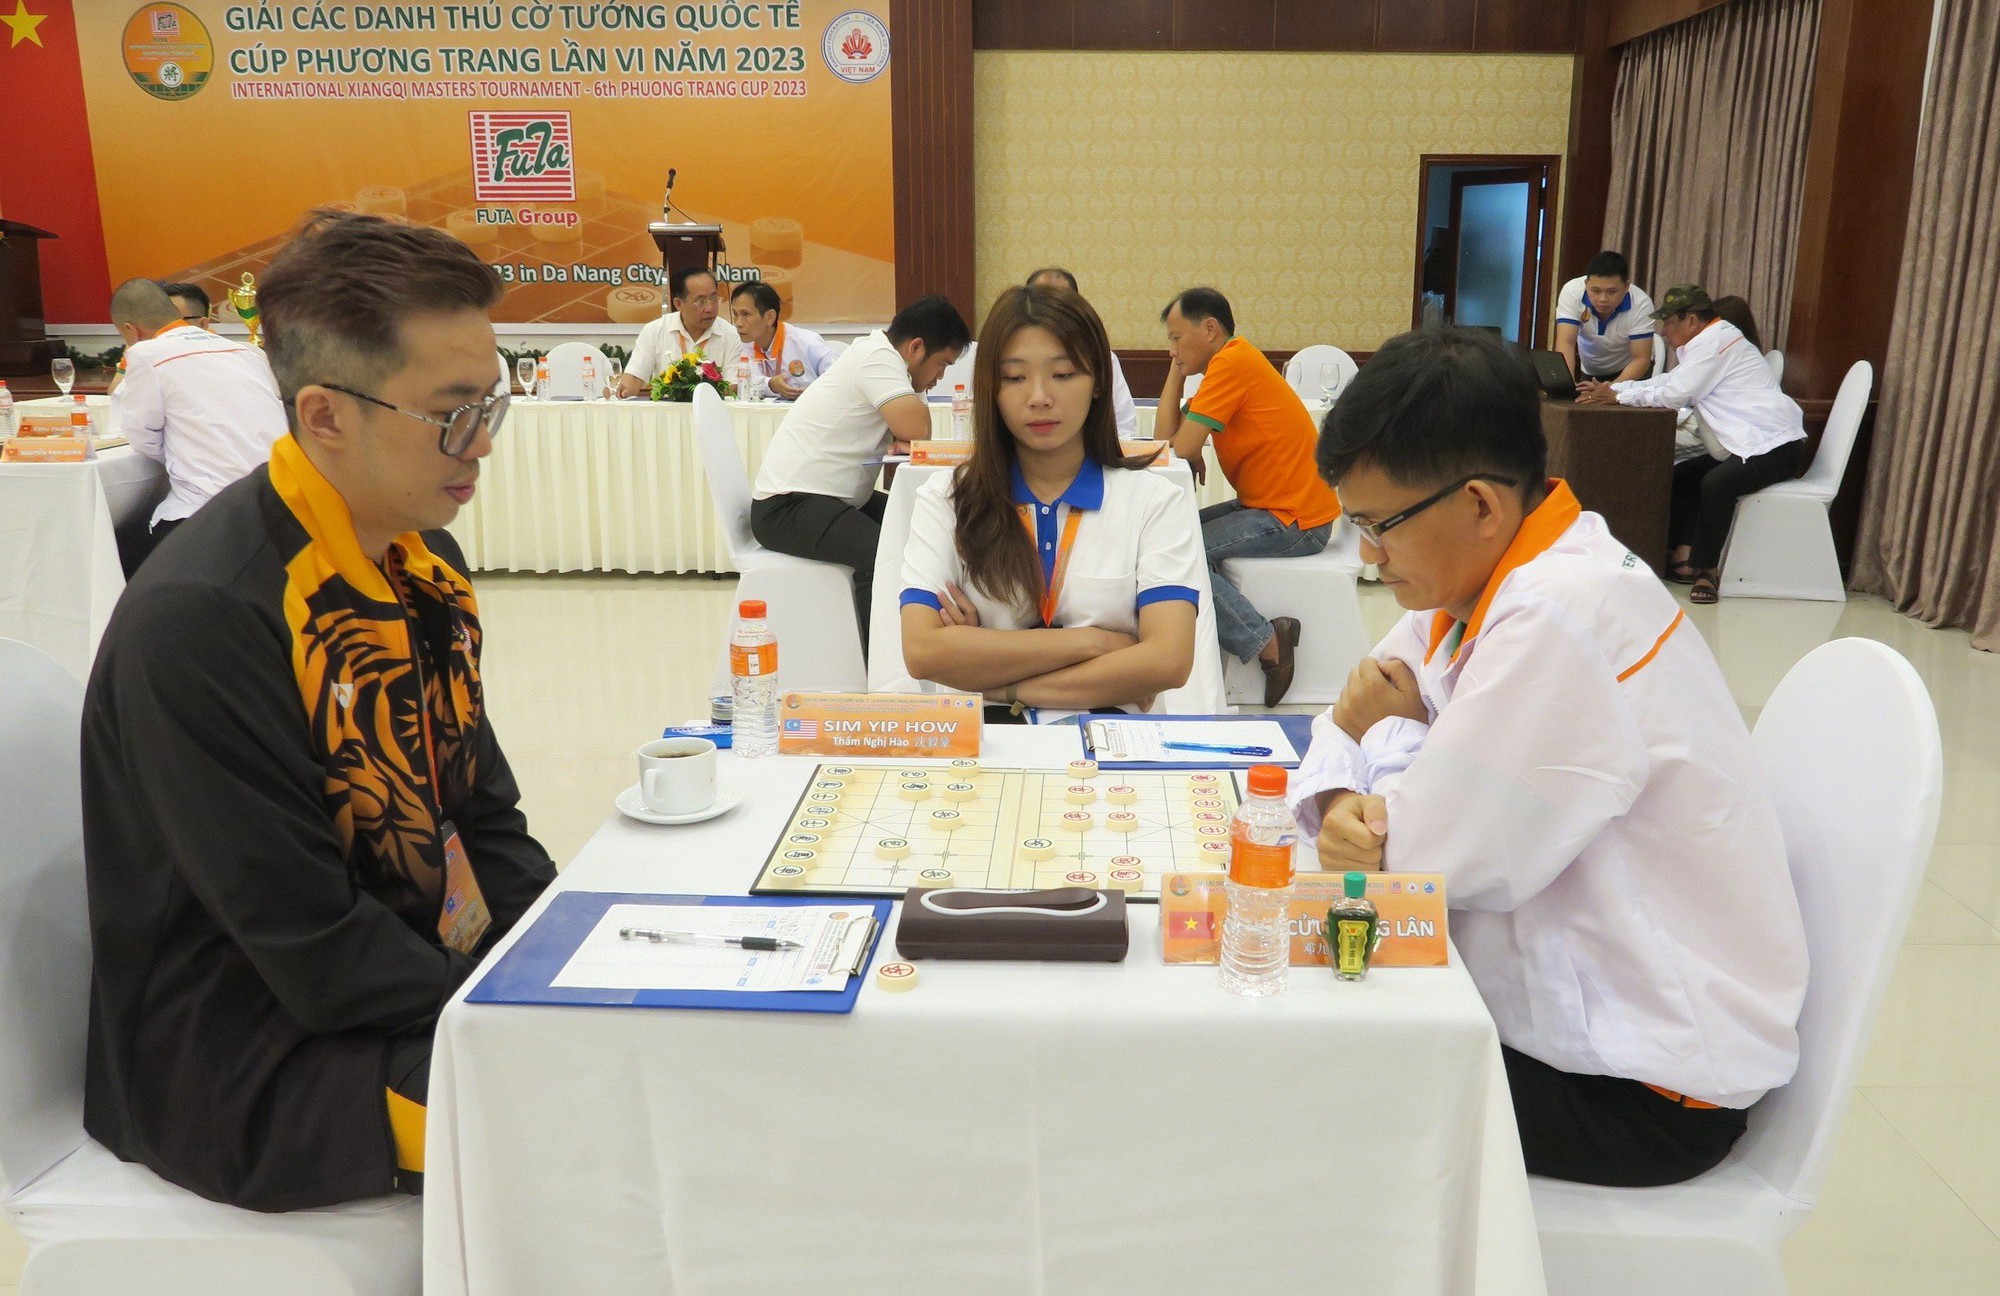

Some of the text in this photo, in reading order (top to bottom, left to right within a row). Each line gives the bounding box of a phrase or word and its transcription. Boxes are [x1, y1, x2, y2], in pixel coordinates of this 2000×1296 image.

[291, 0, 347, 30] CÁC
[354, 6, 436, 30] DANH
[230, 42, 288, 73] CÚP
[297, 47, 431, 73] PHƯƠNG
[438, 48, 541, 73] TRANG
[551, 37, 606, 73] LẦN
[615, 48, 644, 72] VI
[655, 40, 726, 72] NĂM
[736, 47, 805, 72] 2023
[232, 81, 345, 98] INTERNATIONAL
[348, 82, 407, 100] XIANGQI
[411, 81, 476, 97] MASTERS
[480, 81, 581, 97] TOURNAMENT
[594, 80, 617, 97] 6th
[621, 81, 683, 97] PHUONG
[687, 81, 737, 96] TRANG
[741, 81, 769, 96] CUP
[773, 80, 807, 96] 2023
[476, 209, 578, 228] FUTA Group
[520, 264, 538, 282] in
[543, 265, 568, 282] Da
[574, 265, 622, 285] Nang
[716, 265, 761, 282] Nam
[823, 719, 959, 734] SIM YIP HOW
[863, 736, 887, 749] Nghị
[889, 736, 910, 748] Hào
[1396, 916, 1435, 937] LÂN
